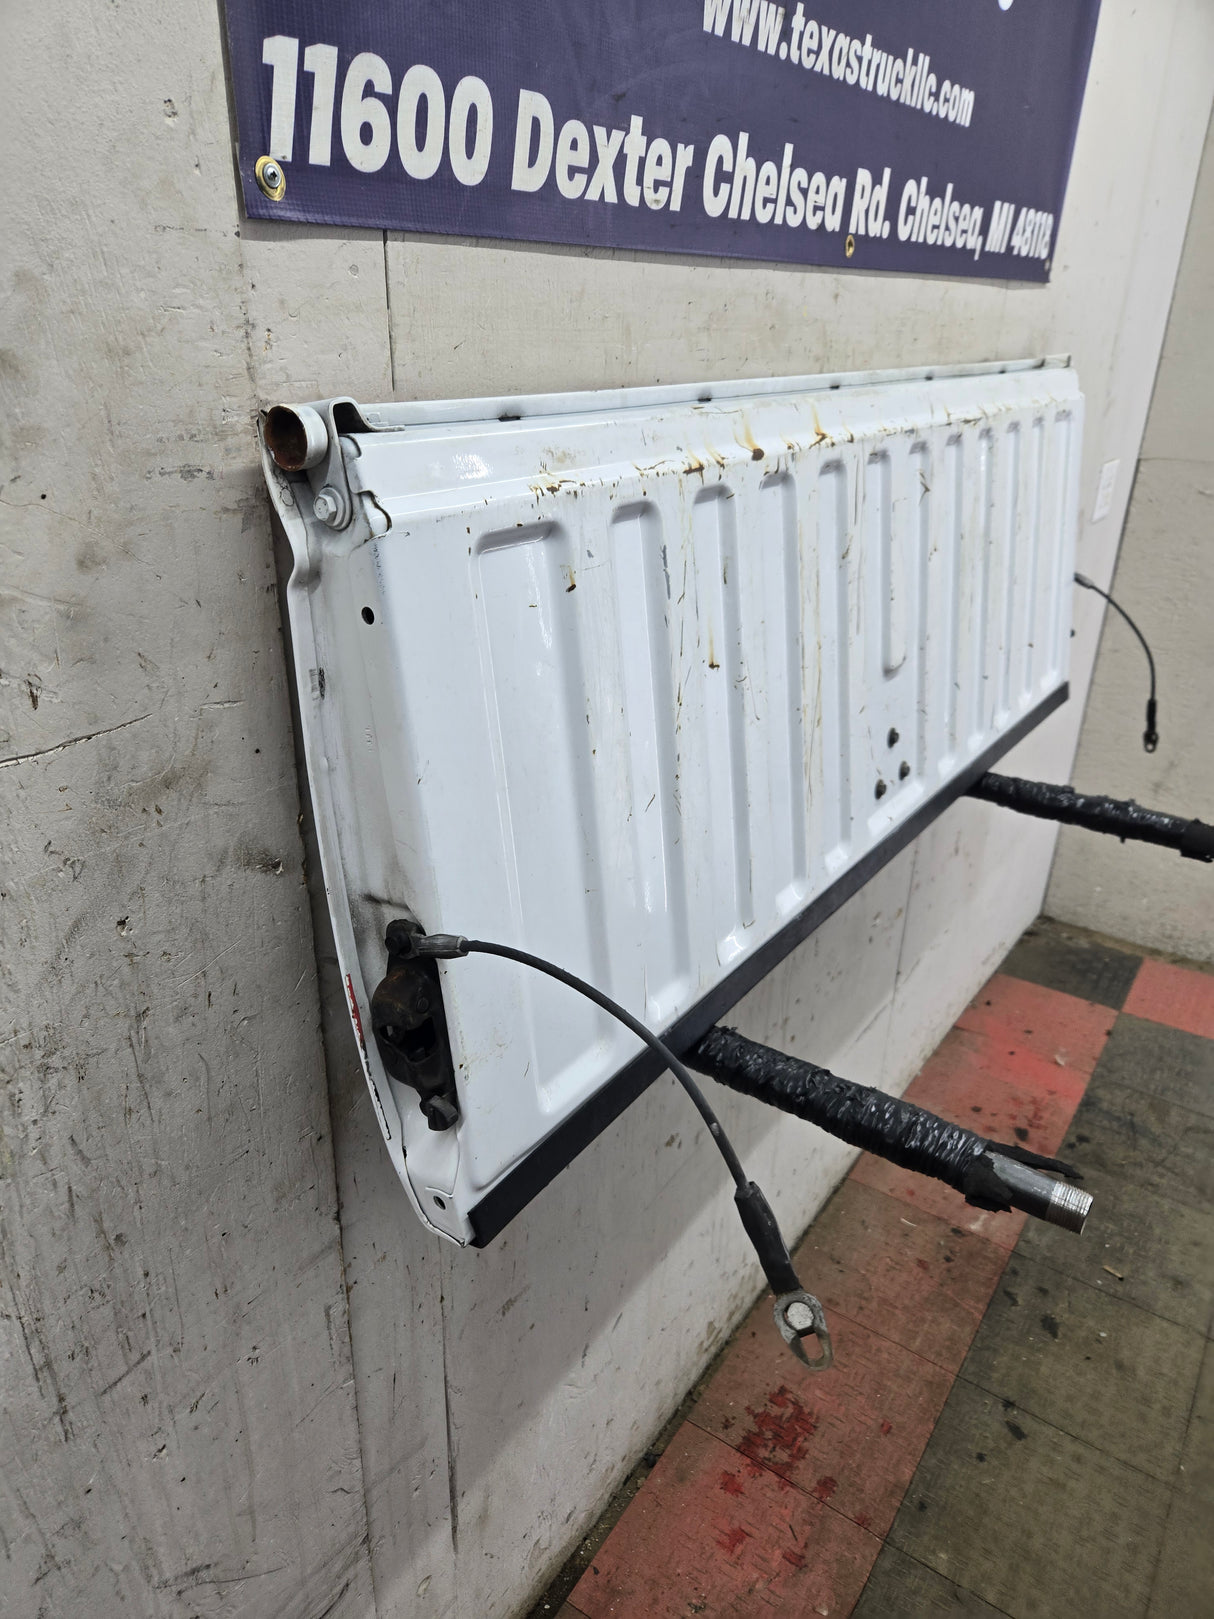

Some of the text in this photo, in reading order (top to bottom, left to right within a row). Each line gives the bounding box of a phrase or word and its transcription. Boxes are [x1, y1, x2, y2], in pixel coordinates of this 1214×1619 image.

[262, 34, 1055, 261] 11600 Dexter Chelsea Rd. Chelsea, MI 48118
[702, 0, 975, 127] www.texastruckllc.com
